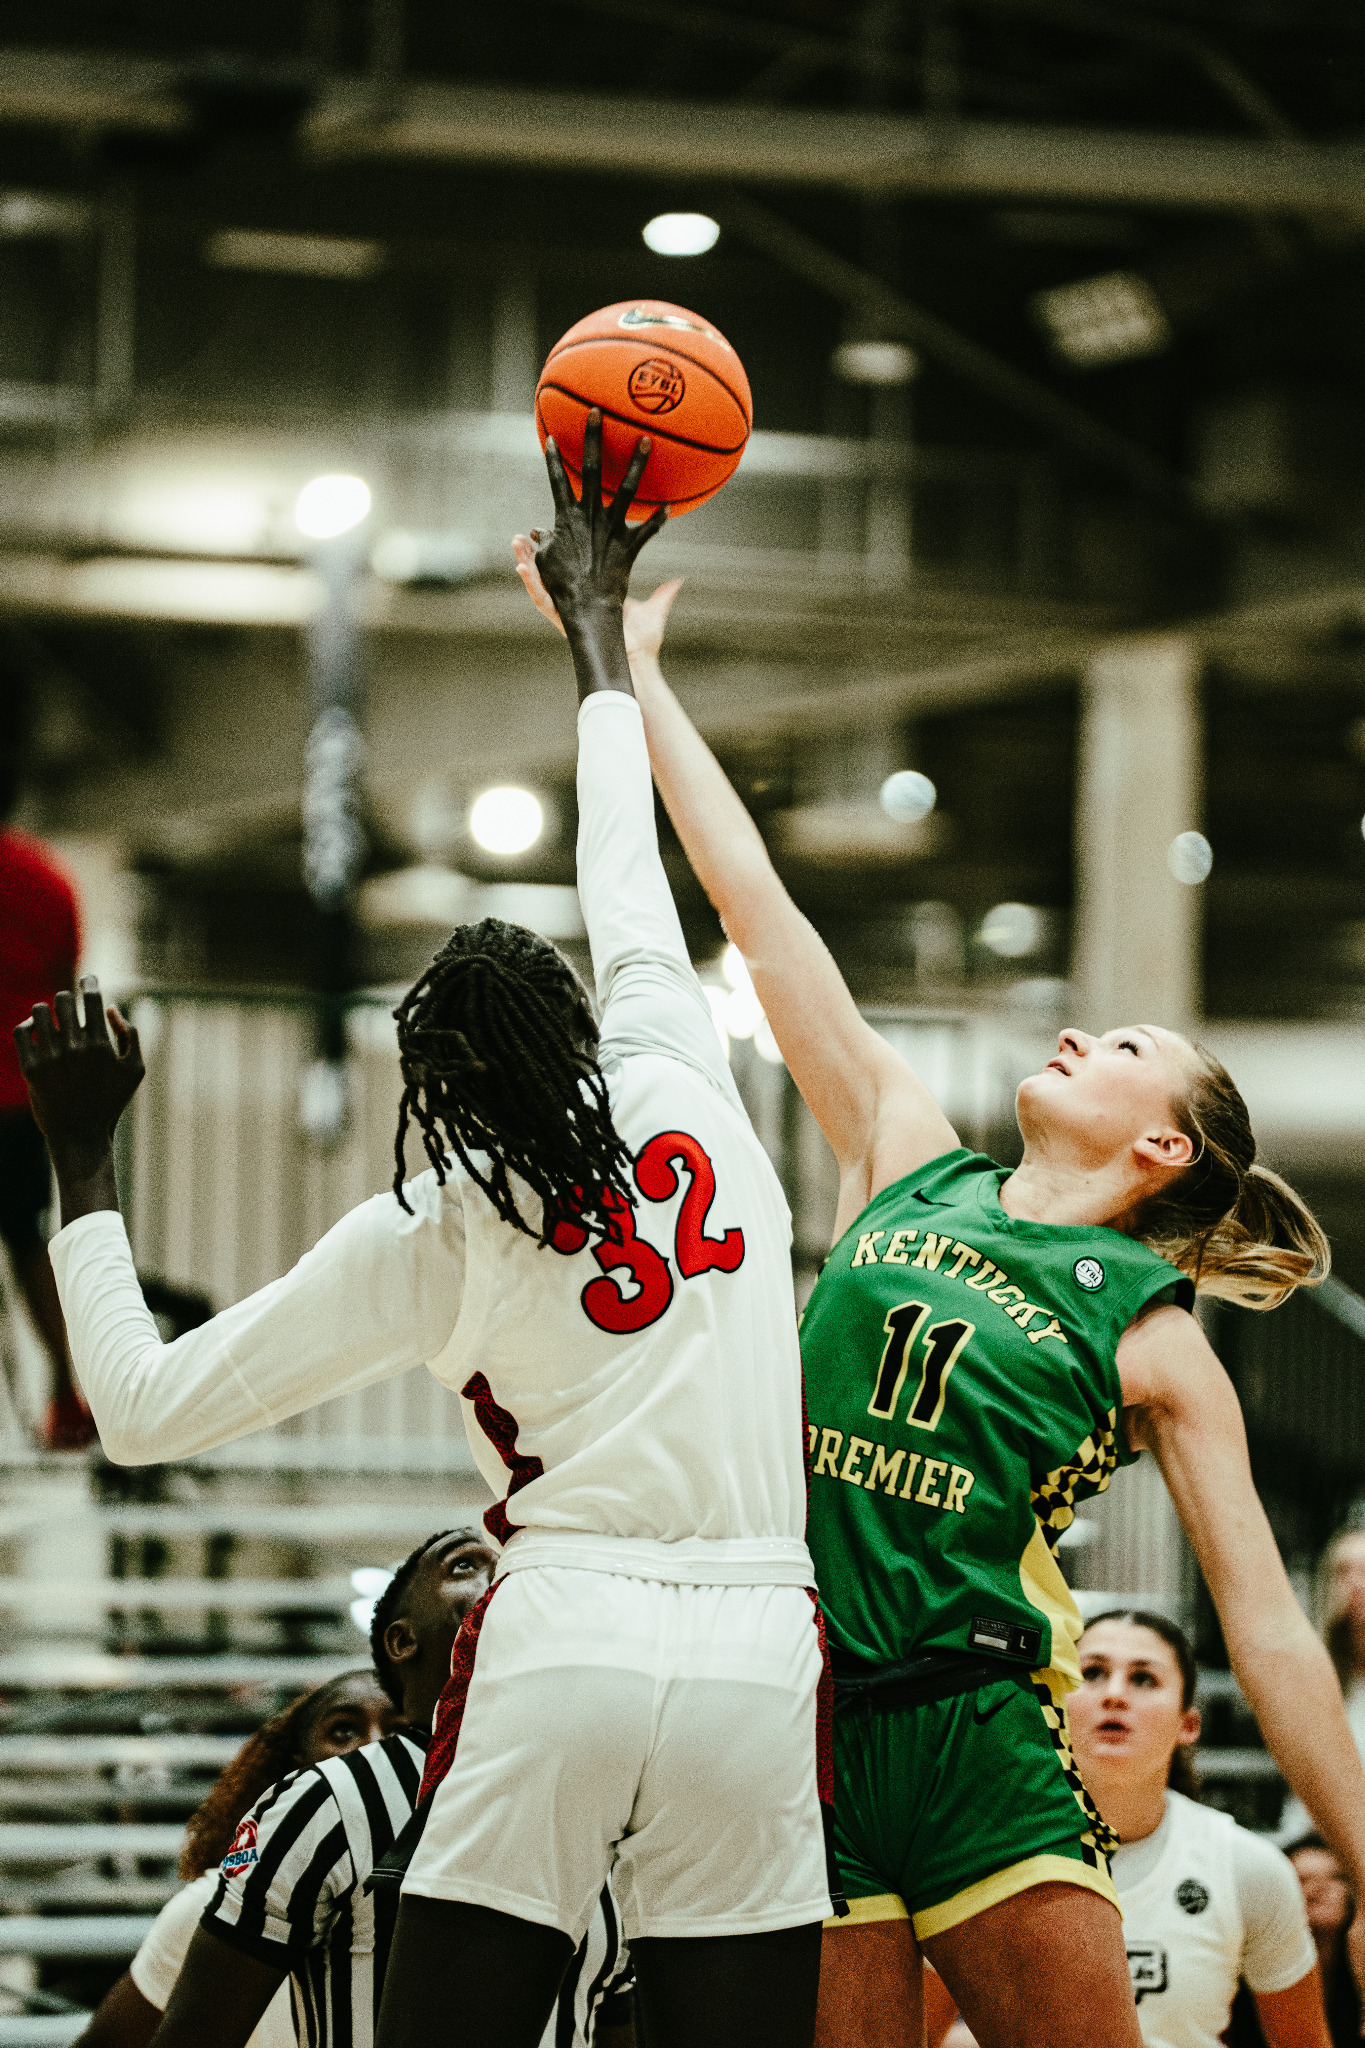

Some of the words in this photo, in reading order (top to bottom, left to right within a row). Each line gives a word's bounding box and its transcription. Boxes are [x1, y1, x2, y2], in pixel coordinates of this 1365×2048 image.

[638, 371, 678, 395] EYBL
[548, 1130, 745, 1335] 32
[850, 1229, 1068, 1345] KENTUCKY
[1081, 1262, 1099, 1284] EYBL
[867, 1299, 976, 1432] 11
[1020, 1635, 1027, 1650] L
